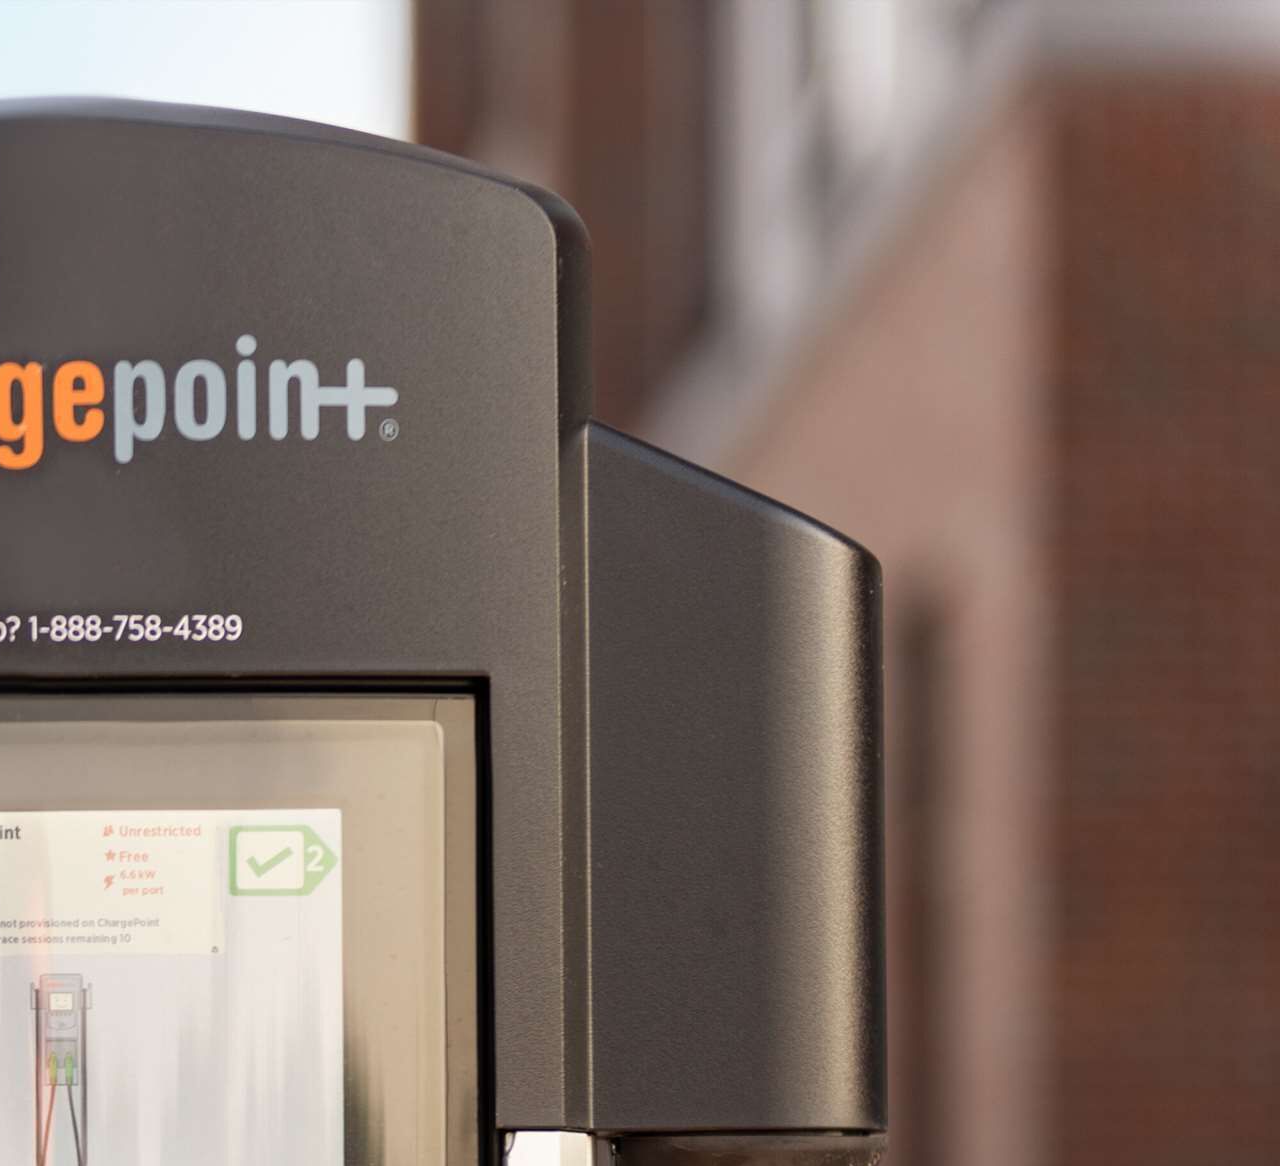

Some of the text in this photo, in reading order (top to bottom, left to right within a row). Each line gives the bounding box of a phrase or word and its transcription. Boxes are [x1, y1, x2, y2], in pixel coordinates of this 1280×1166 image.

[27, 614, 244, 643] 1-888-758-4389
[119, 825, 202, 838] Unrestricted
[119, 850, 149, 863] Free
[306, 845, 325, 873] 2
[122, 886, 165, 897] per port
[0, 918, 17, 929] not
[18, 917, 80, 930] provisioned
[81, 918, 95, 928] on
[97, 917, 160, 930] ChargePoint
[21, 934, 64, 944] sessions
[65, 933, 117, 945] remaining
[119, 932, 132, 944] 10
